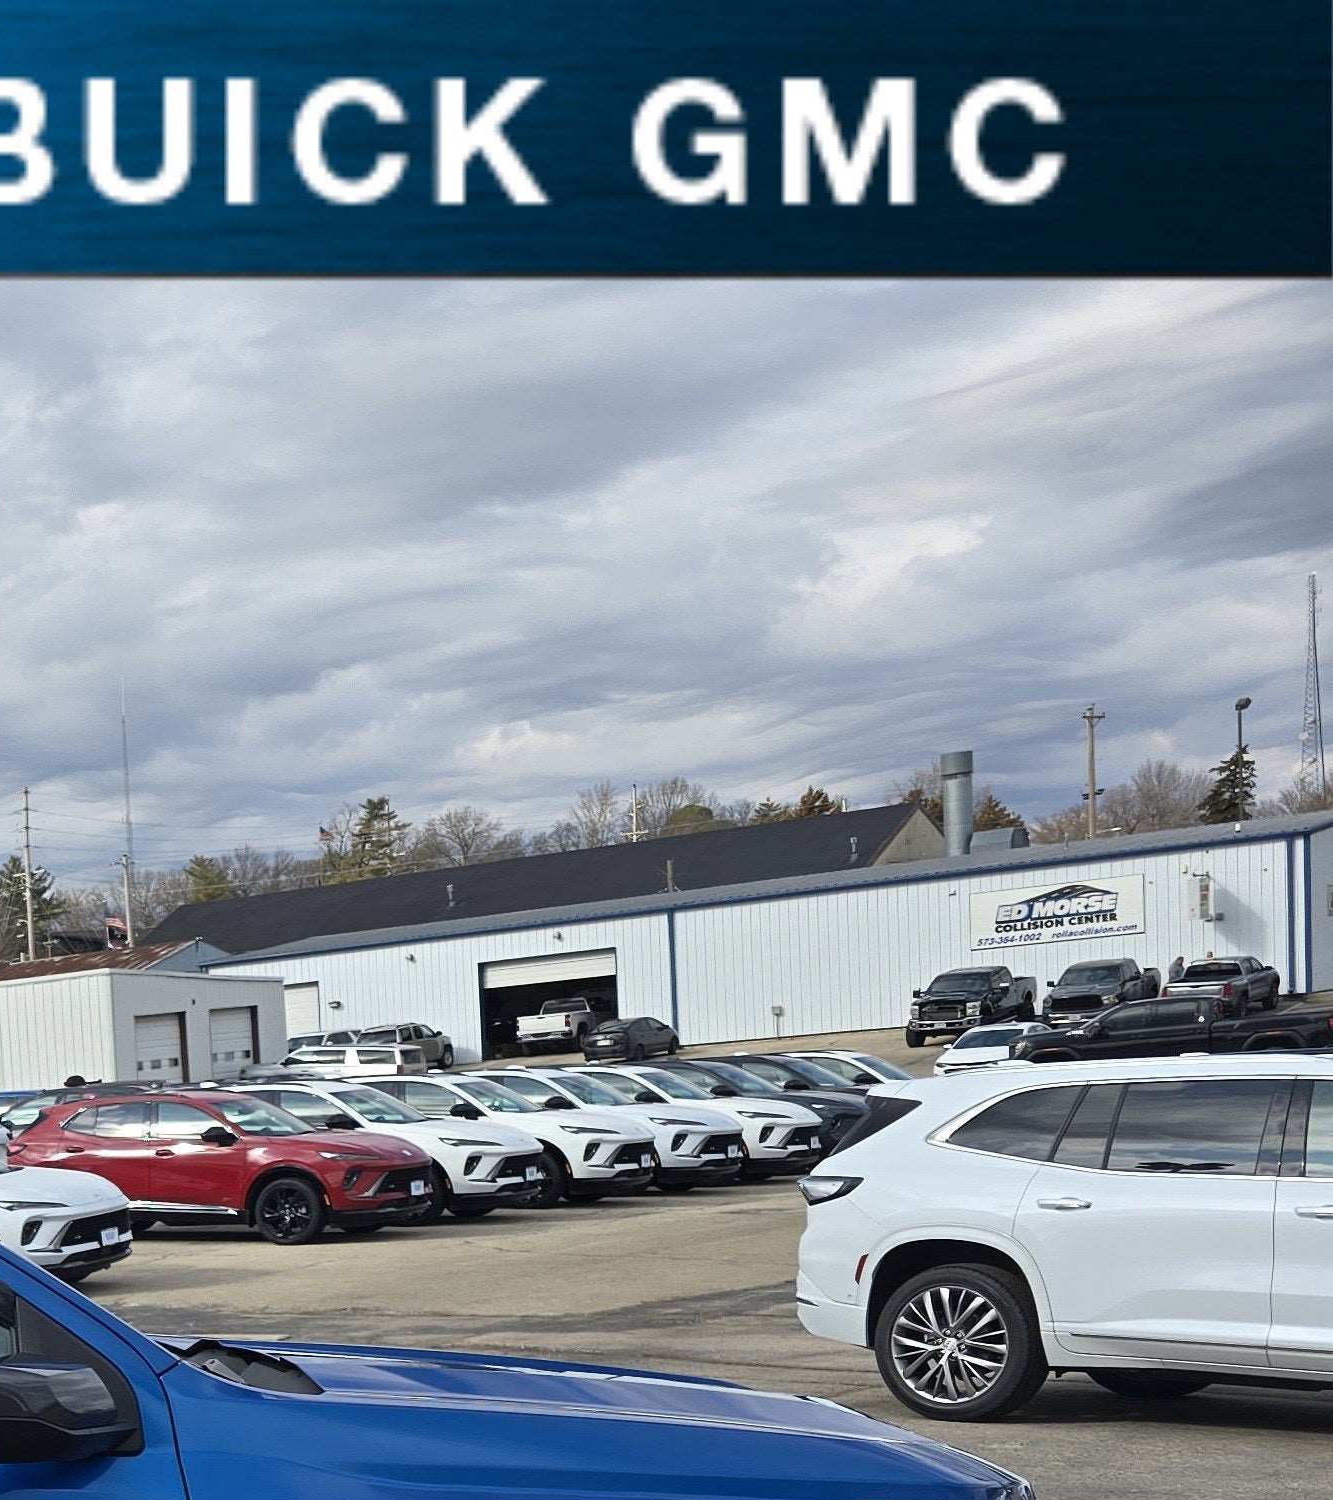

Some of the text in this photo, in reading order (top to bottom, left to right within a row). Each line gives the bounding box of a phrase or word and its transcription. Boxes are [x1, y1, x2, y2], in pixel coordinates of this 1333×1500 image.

[995, 892, 1119, 924] ED MORSE
[994, 912, 1118, 934] COLLISION CENTER
